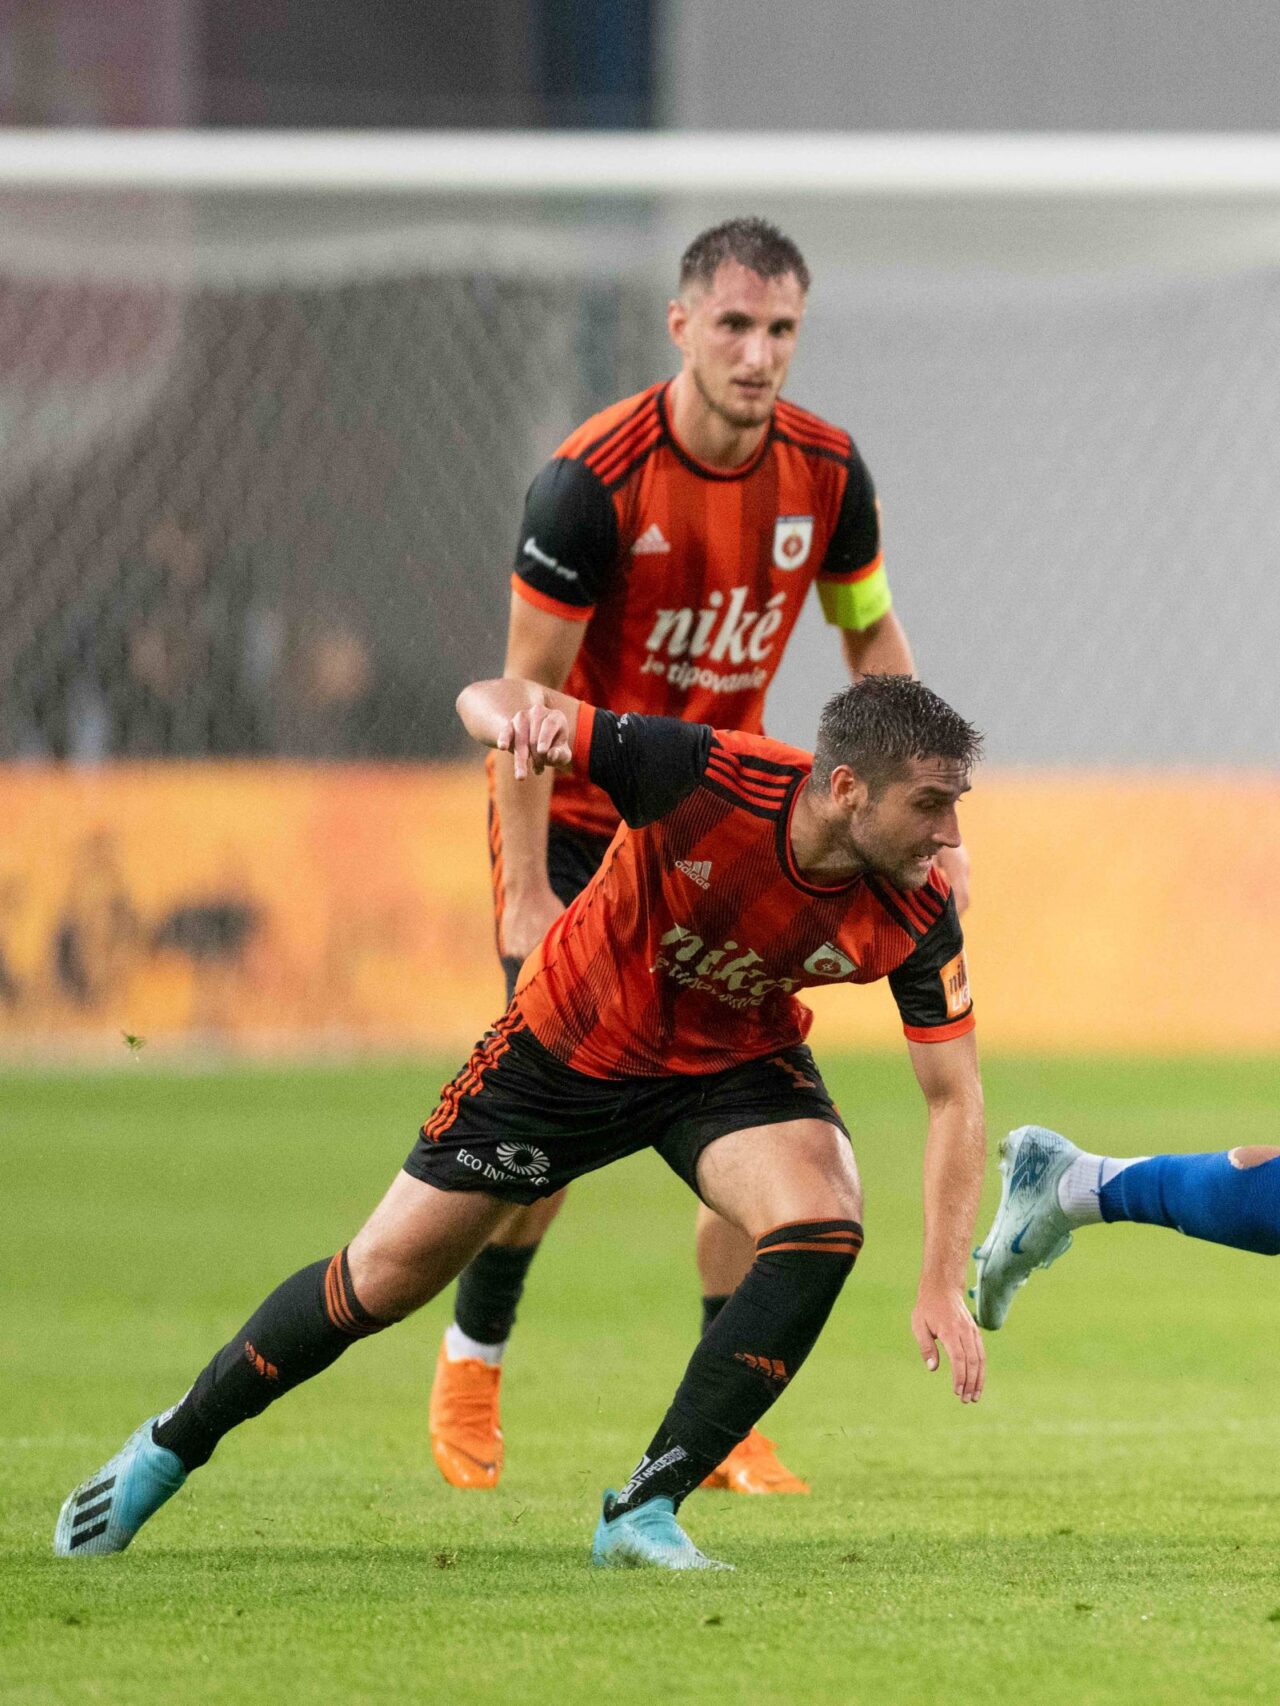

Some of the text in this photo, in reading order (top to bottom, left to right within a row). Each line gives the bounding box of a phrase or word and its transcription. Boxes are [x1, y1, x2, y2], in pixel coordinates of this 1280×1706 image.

[646, 585, 786, 664] niké
[675, 861, 711, 889] adidas
[457, 1149, 482, 1171] ECO
